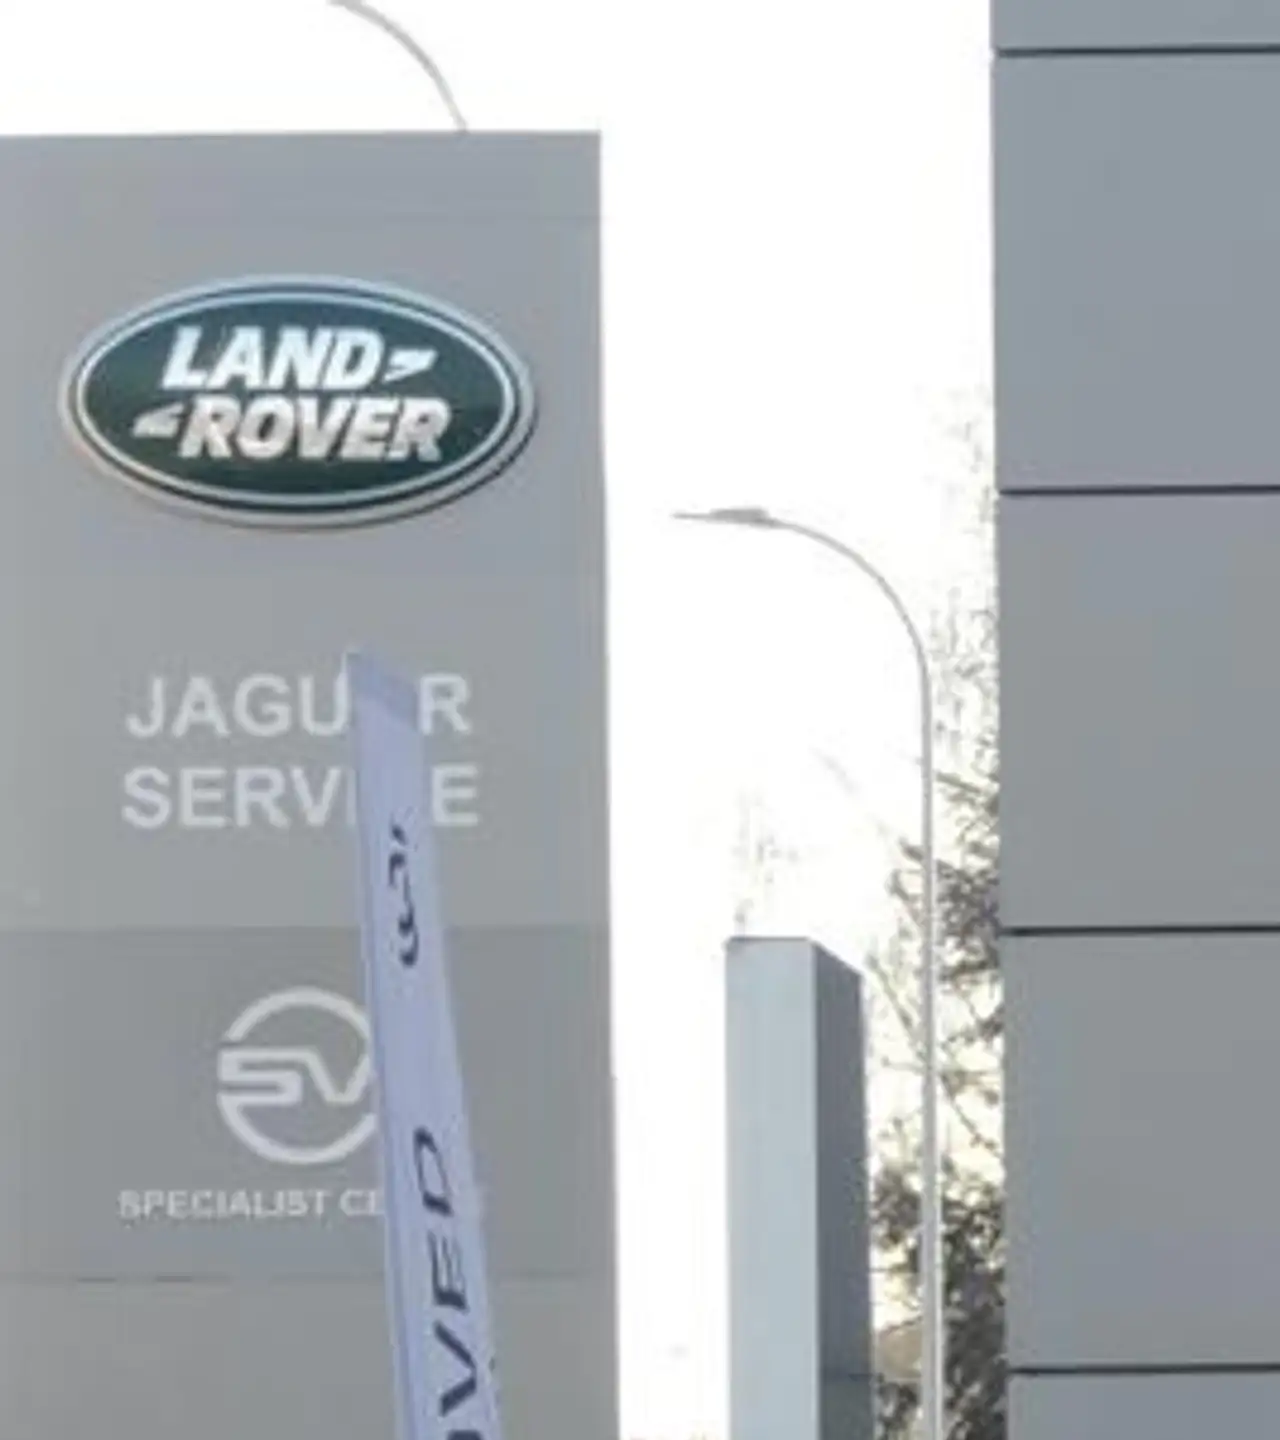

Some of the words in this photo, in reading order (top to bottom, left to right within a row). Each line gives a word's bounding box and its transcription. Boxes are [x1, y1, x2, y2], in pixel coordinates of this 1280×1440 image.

[161, 325, 386, 391] LAND
[178, 395, 454, 463] ROVER
[124, 672, 472, 738] JAGUR
[120, 764, 480, 829] SERVIE
[117, 1188, 334, 1219] SPECIALIST
